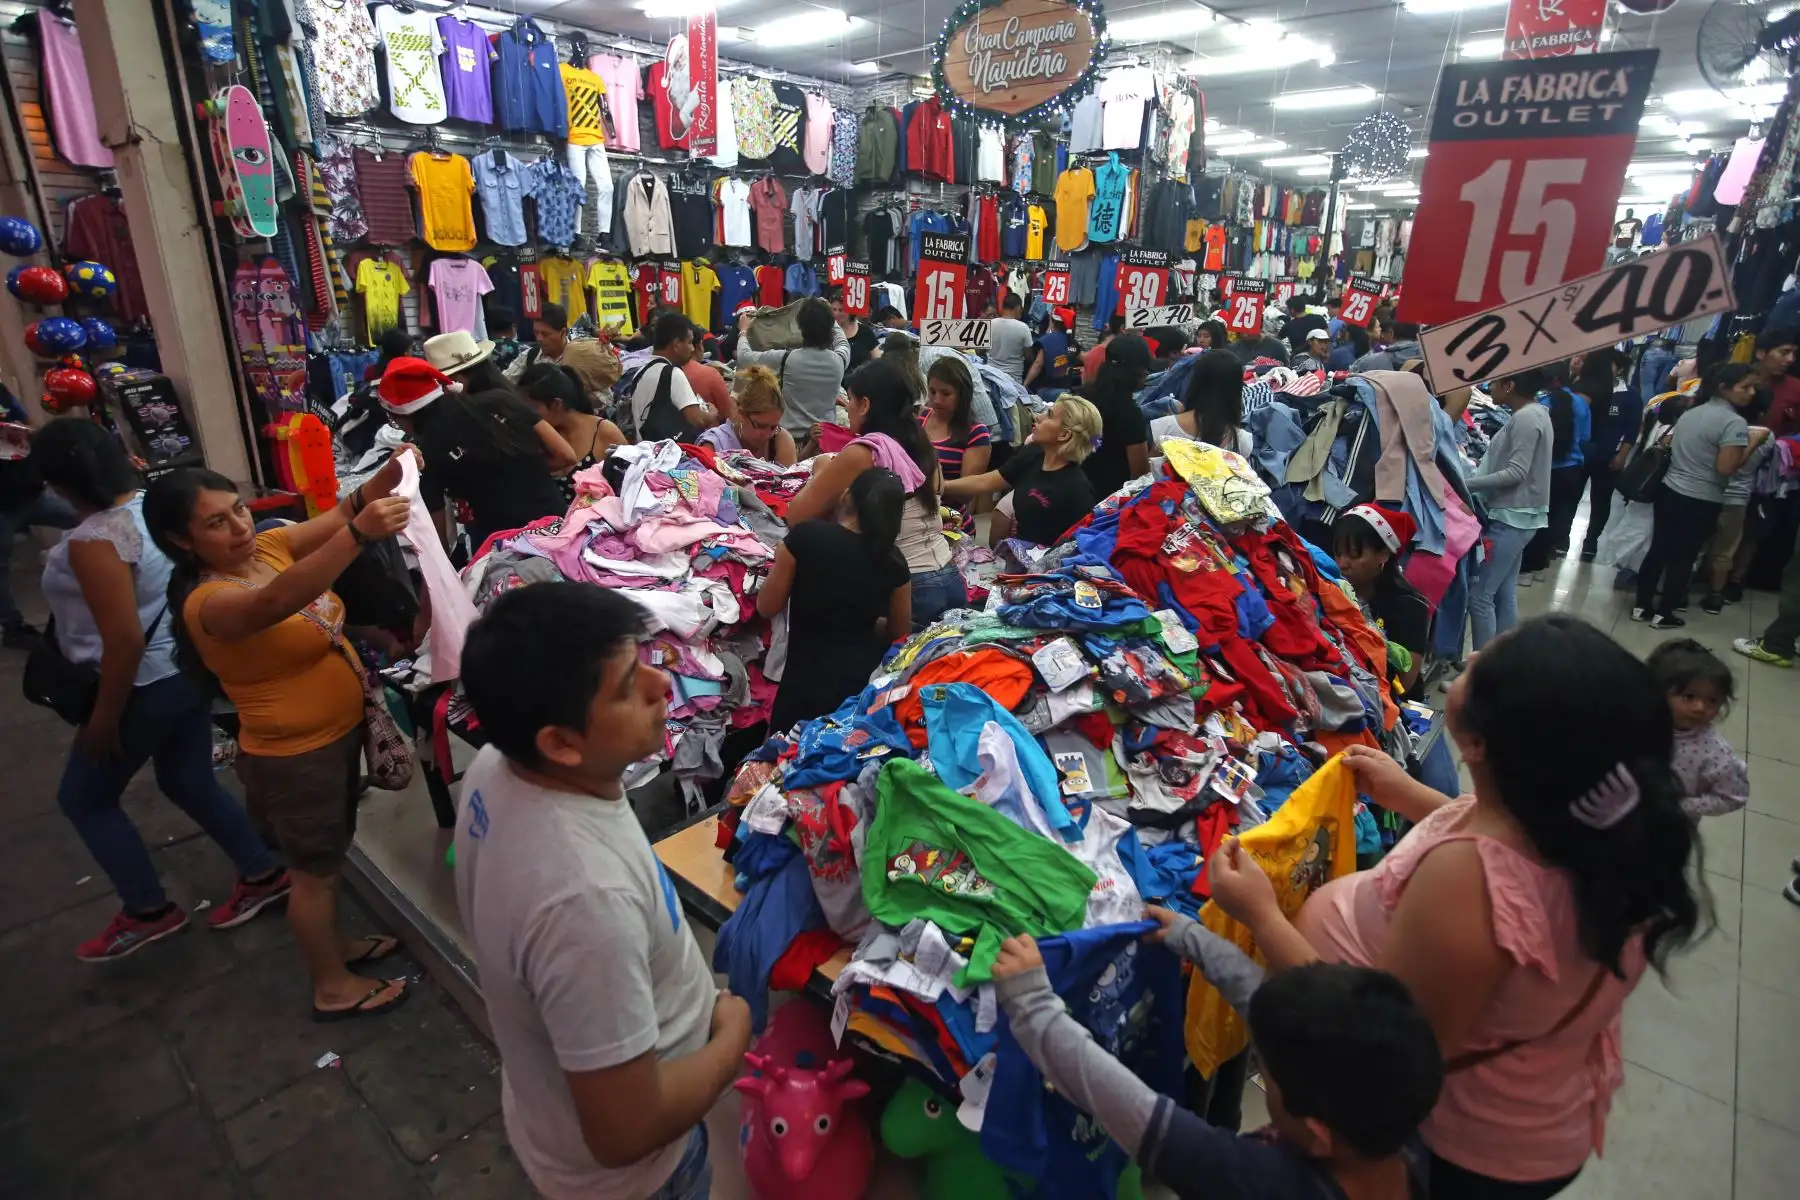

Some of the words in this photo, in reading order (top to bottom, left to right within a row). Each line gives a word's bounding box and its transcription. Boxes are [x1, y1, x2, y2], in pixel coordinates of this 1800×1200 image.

[965, 24, 1000, 54] Gran
[1002, 16, 1077, 55] Campaña
[1511, 41, 1527, 52] LA
[1532, 30, 1592, 49] FABRICA
[969, 47, 1068, 94] Navideña
[1456, 78, 1489, 107] LA
[1500, 68, 1629, 104] FABRICA
[1453, 104, 1623, 128] OUTLET
[1455, 158, 1587, 303] 15
[925, 237, 934, 248] LA
[935, 239, 965, 253] FABRICA
[925, 249, 963, 260] OUTLET
[1130, 250, 1138, 258] LA
[1138, 251, 1168, 260] FABRICA
[831, 256, 845, 280] 30
[852, 262, 869, 270] FABRICA
[665, 276, 679, 303] 30
[847, 276, 866, 309] 39
[926, 270, 955, 319] 15
[1047, 276, 1066, 302] 25
[1125, 271, 1160, 310] 39
[1133, 308, 1149, 327] 2
[1151, 310, 1161, 324] X
[1232, 296, 1258, 329] 25
[1343, 293, 1372, 322] 25
[926, 320, 941, 345] 3
[941, 323, 951, 341] X
[1444, 314, 1510, 382] 3
[1518, 297, 1558, 355] X
